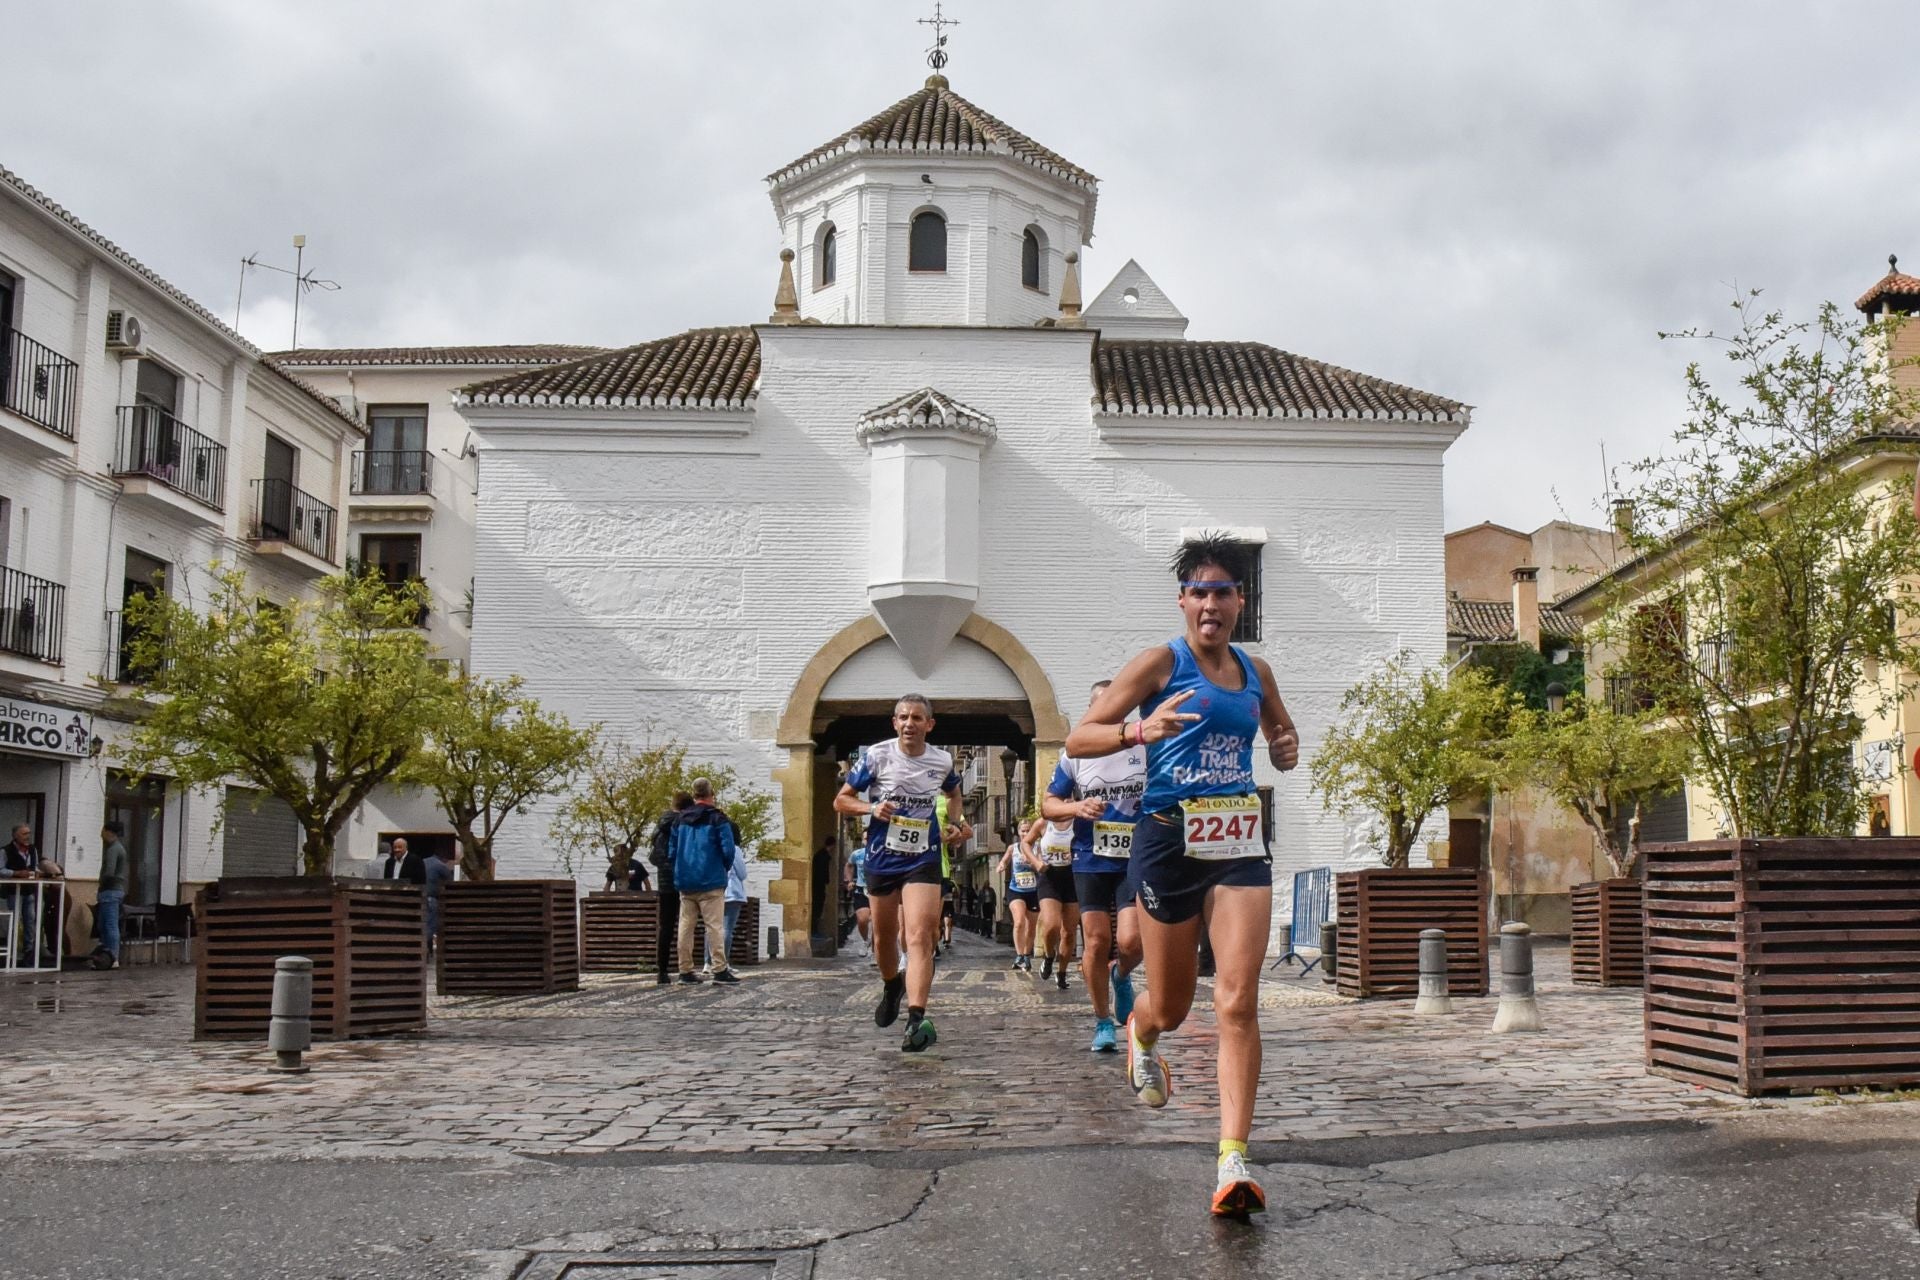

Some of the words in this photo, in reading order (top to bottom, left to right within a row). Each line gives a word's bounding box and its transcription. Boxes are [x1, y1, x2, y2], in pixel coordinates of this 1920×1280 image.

[1199, 750, 1241, 769] TRAIL
[899, 829, 920, 844] 58
[1187, 814, 1259, 843] 2247
[1100, 834, 1131, 849] 138
